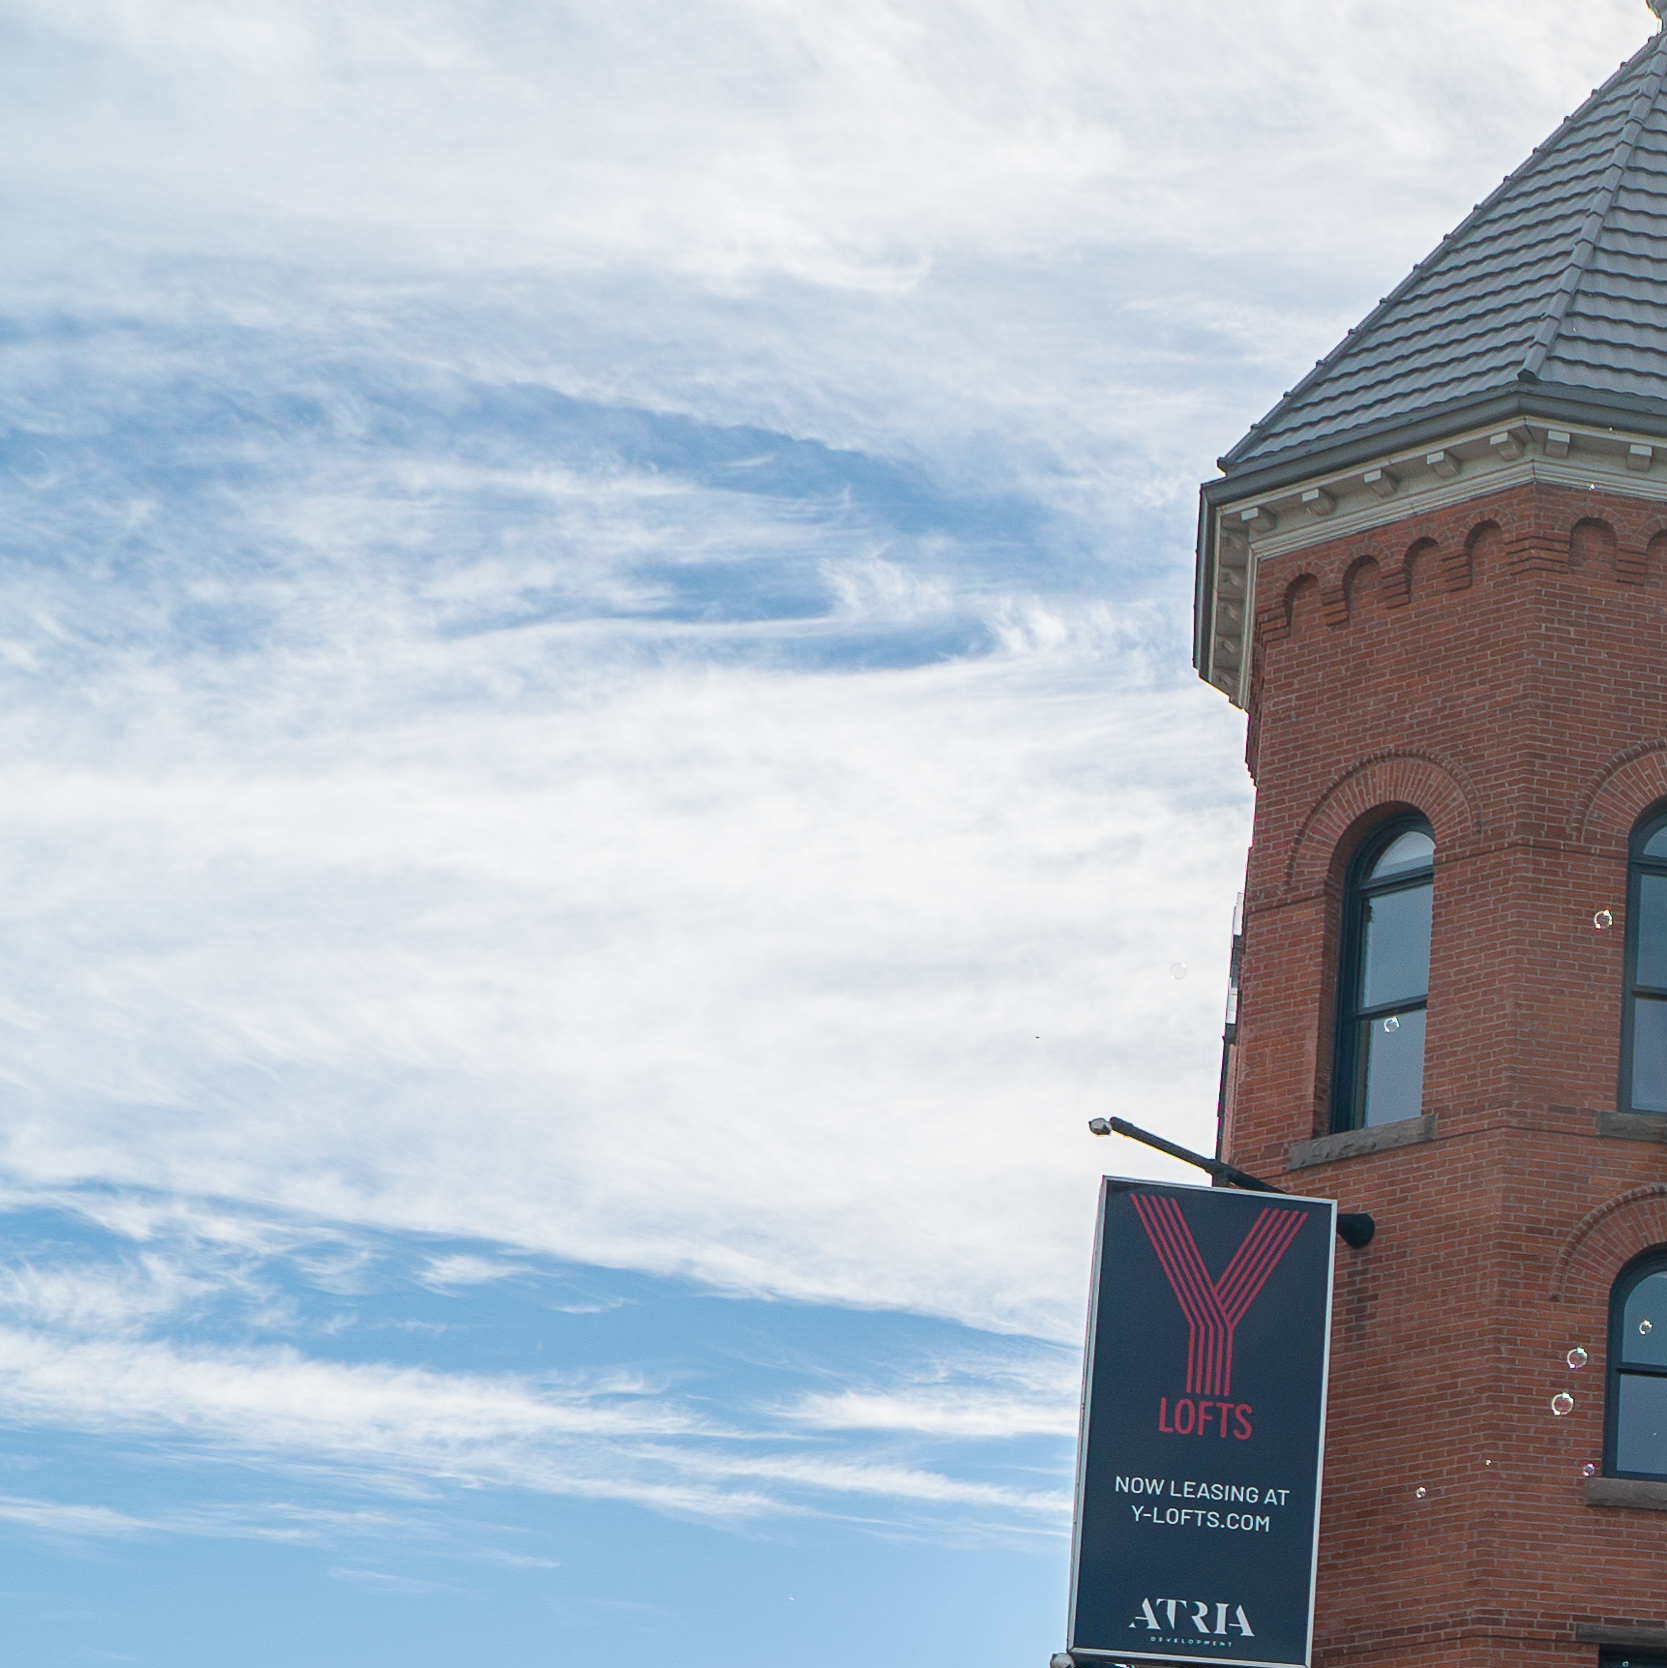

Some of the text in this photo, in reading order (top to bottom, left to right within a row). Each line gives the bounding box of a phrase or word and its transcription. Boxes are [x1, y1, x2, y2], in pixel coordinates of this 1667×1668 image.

[1130, 1193, 1309, 1396] Y
[1159, 1397, 1253, 1440] LOFTS
[1115, 1476, 1290, 1506] NOW LEASING AT
[1131, 1505, 1270, 1532] Y-LOFTS.COM
[1128, 1597, 1255, 1637] ATRIA
[1150, 1636, 1233, 1647] DEVELOPMENT
